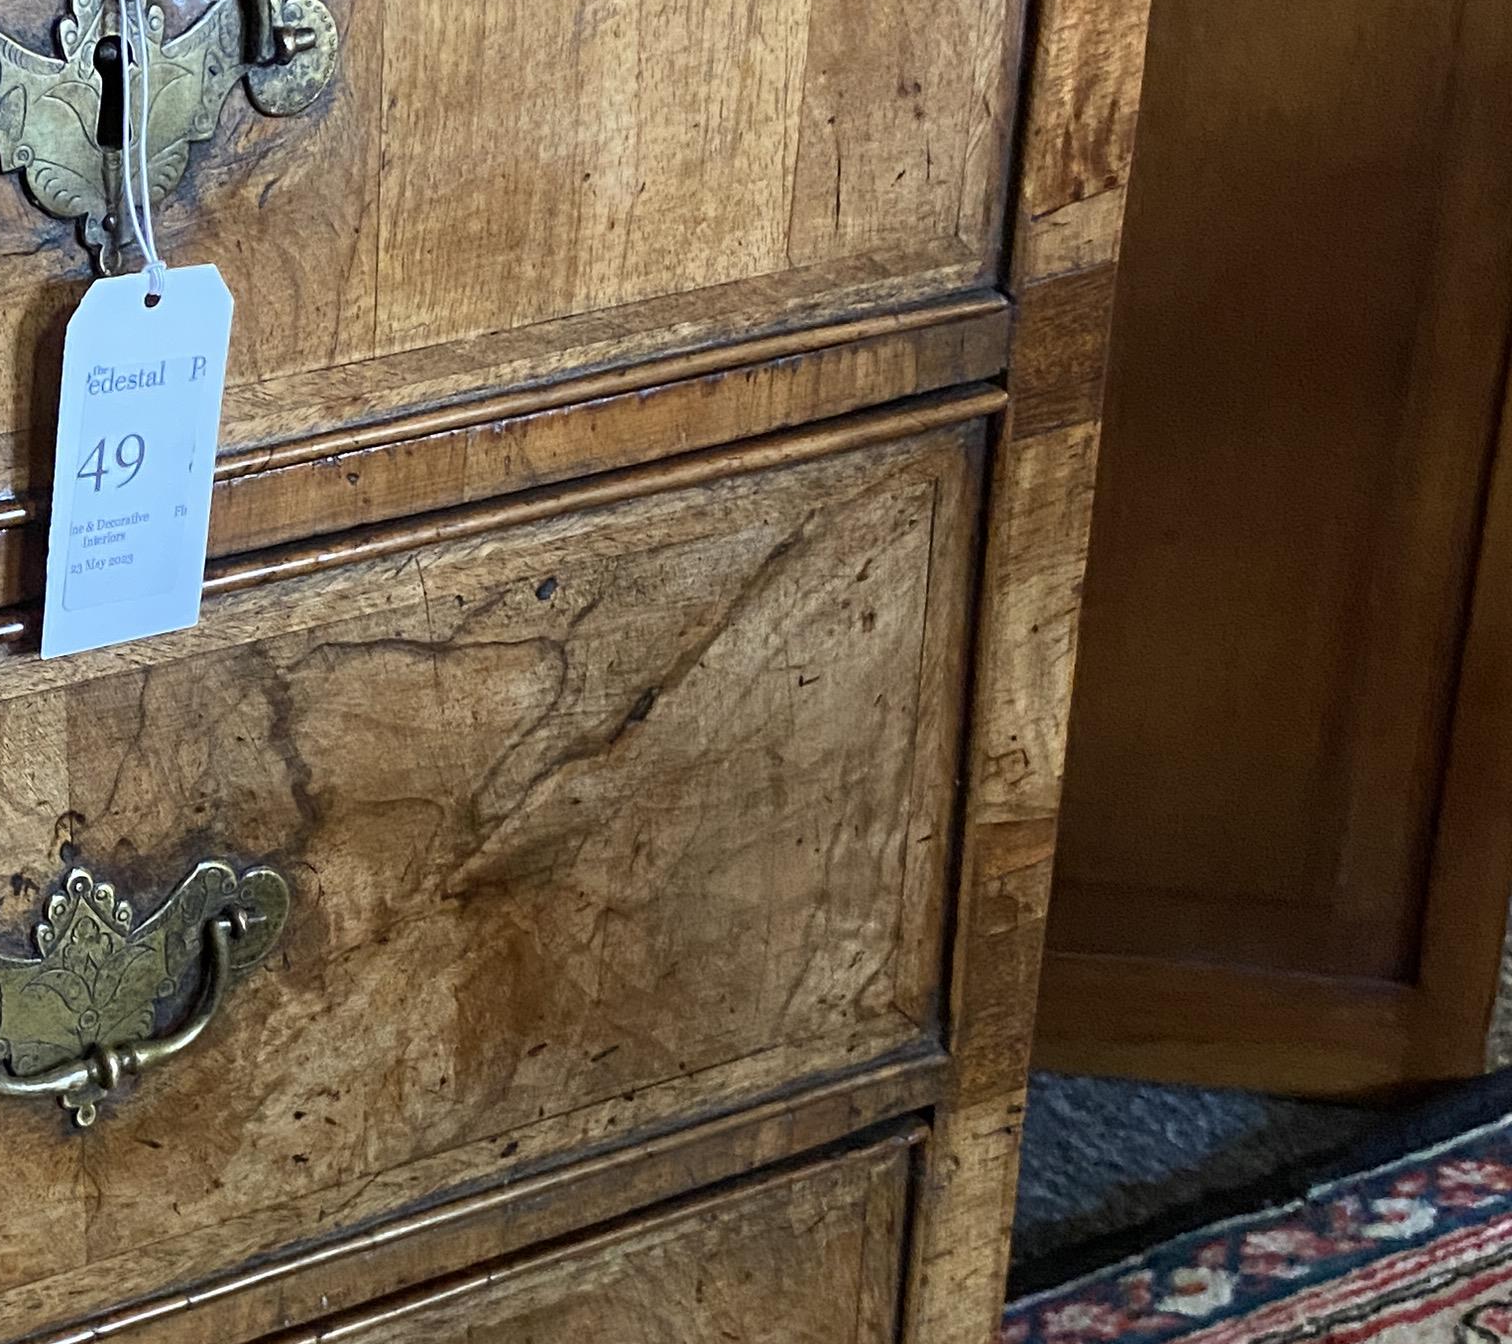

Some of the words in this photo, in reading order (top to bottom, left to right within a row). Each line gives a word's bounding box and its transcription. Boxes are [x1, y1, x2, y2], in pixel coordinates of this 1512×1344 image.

[86, 360, 166, 396] edestal
[76, 433, 146, 493] 49
[86, 520, 95, 533] &
[97, 511, 150, 530] Decorative
[82, 531, 126, 548] Interiors
[85, 557, 107, 571] May
[108, 553, 134, 567] 2023
